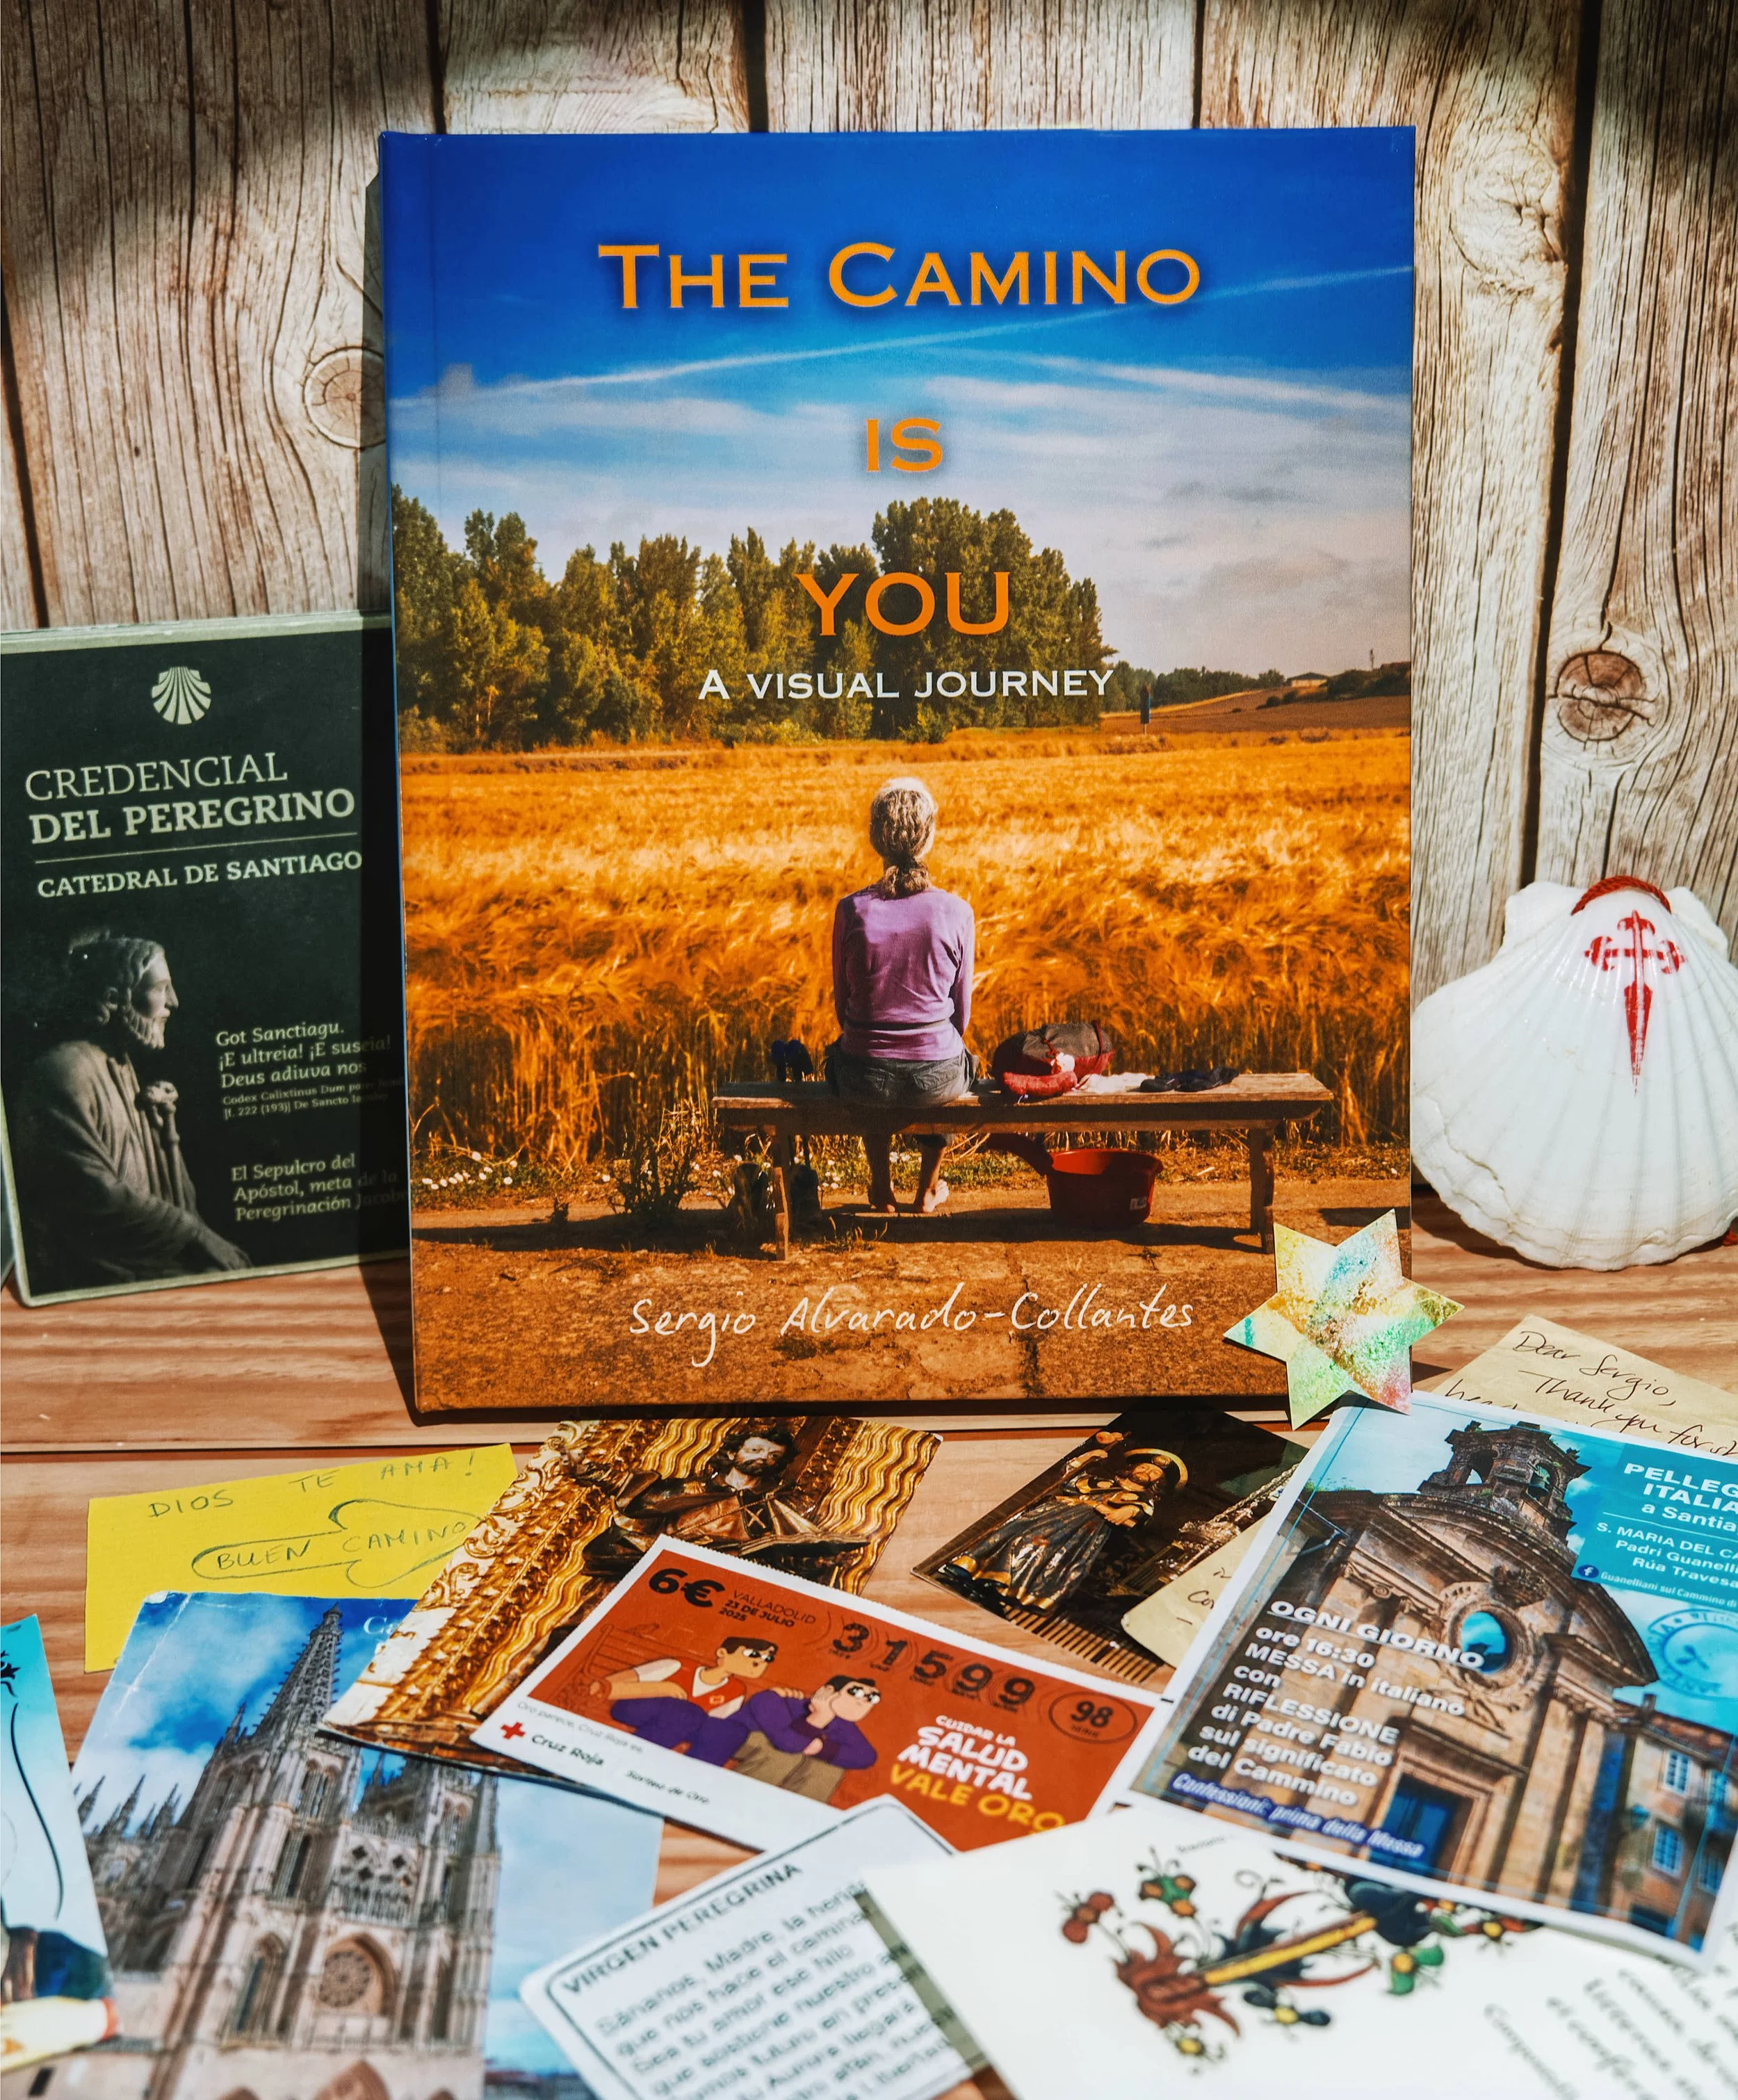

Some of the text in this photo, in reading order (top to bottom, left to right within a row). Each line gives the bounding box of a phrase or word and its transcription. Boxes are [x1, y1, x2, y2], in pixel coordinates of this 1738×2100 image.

[865, 417, 943, 473] IS
[795, 571, 1010, 637] YOU
[697, 669, 1115, 700] A VISUAL JOURNEY
[25, 752, 289, 801] CREDENCIAL
[29, 788, 355, 845] DEL PEREGRINO
[37, 851, 363, 898] CATEDRAL DE SANTIAGO
[216, 1022, 345, 1047] Got Sanctiagu.
[221, 1061, 367, 1089] Deus adiuva nos
[222, 1093, 258, 1105] Codex
[261, 1084, 318, 1101] Calixtinus
[320, 1084, 346, 1094] Dum
[231, 1153, 356, 1182] El Sepulcro del
[234, 1180, 304, 1205] Apóstol,
[309, 1177, 352, 1194] meta
[235, 1196, 352, 1222] Peregrinación
[629, 1282, 1194, 1368] Sergio Alvarado-Collantes
[1512, 1330, 1582, 1360] Dear
[1517, 1369, 1616, 1414] Thank
[147, 1489, 234, 1518] DIOS
[288, 1469, 342, 1493] TE
[1617, 1526, 1675, 1547] MARIA
[1680, 1539, 1714, 1556] DEL
[1641, 1503, 1738, 1534] a Santia
[217, 1521, 467, 1570] BUEN CAMINO
[1615, 1539, 1662, 1557] Padri
[1632, 1556, 1666, 1573] Rúa
[649, 1568, 817, 1626] 6€ VALLADOLID
[718, 1607, 747, 1622] 2025
[740, 1606, 758, 1618] DE
[758, 1611, 795, 1628] JULIO
[1255, 1625, 1376, 1670] ore 16:30
[1269, 1600, 1486, 1669] OGNI GIORNO
[1233, 1665, 1282, 1689] con
[1244, 1643, 1466, 1717] MESSA in italiano
[935, 1714, 1017, 1747] CUIDAR LA
[1070, 1700, 1115, 1728] 98
[1211, 1703, 1393, 1768] di Padre Fabio
[1222, 1682, 1400, 1745] RIFLESSIONE
[530, 1734, 606, 1767] Cruz Roja
[917, 1725, 1029, 1772] SALUD
[1199, 1724, 1379, 1789] sul significato
[889, 1763, 975, 1807] VALE
[896, 1743, 1033, 1801] MENTAL
[1187, 1745, 1358, 1807] del Cammino
[561, 1862, 804, 1997] VIRGEN PEREGRINA
